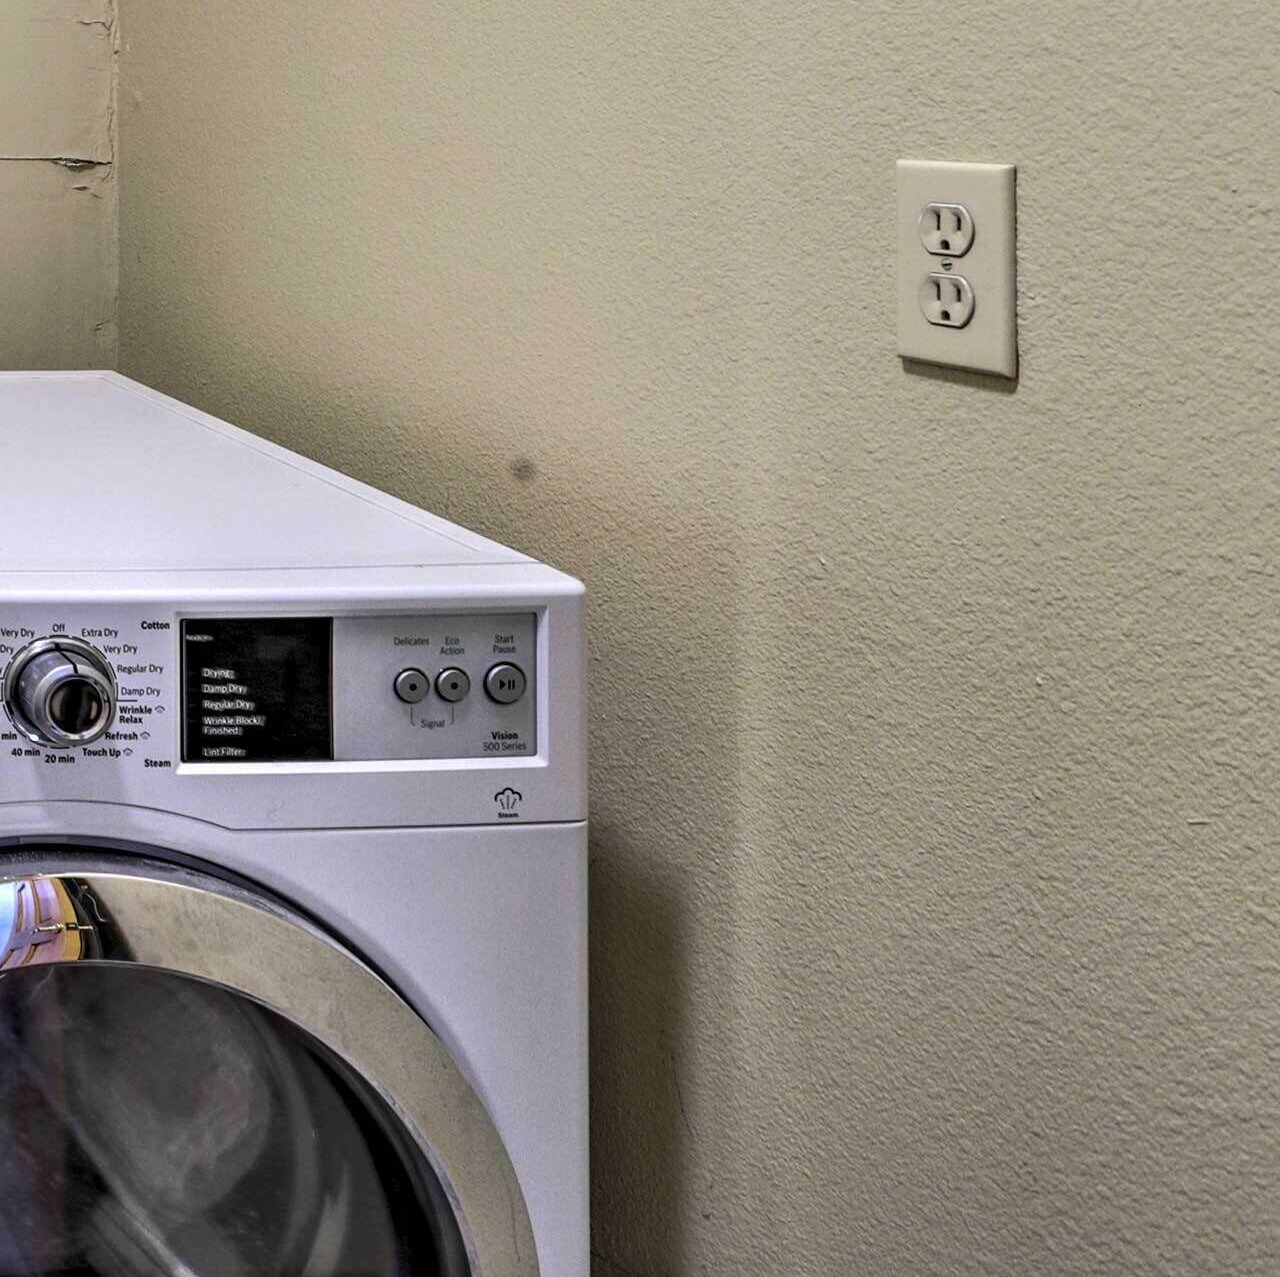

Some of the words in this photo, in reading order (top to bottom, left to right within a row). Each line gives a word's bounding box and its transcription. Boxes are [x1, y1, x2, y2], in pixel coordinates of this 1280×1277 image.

[52, 624, 66, 633] Off
[141, 621, 171, 630] Cotton
[0, 628, 20, 639] Very
[20, 628, 36, 639] Dry
[81, 628, 101, 637] Extra
[103, 628, 119, 639] Dry
[394, 637, 430, 646] Delicates
[445, 637, 460, 645] Eco
[495, 635, 514, 644] Start
[0, 644, 15, 656] Dry
[103, 644, 121, 655] Very
[122, 644, 138, 655] Dry
[440, 647, 465, 655] Action
[493, 645, 517, 654] Pause
[117, 664, 146, 675] Regular
[147, 664, 164, 675] Dry
[202, 668, 235, 679] Drying
[121, 687, 145, 698] Damp
[145, 687, 161, 698] Dry
[202, 684, 227, 695] Damp
[228, 684, 247, 695] Dry
[119, 705, 152, 714] Wrinkle
[203, 700, 235, 711] Regular
[236, 700, 254, 711] Dry
[119, 716, 143, 724] Relax
[203, 717, 235, 726] Wrinkle
[421, 719, 445, 729] Signal
[204, 727, 242, 735] Finished
[491, 731, 518, 740] Vision
[1, 732, 18, 741] min
[105, 731, 138, 741] Refresh
[483, 742, 500, 751] 500
[502, 741, 527, 751] Series
[11, 748, 23, 757] 40
[24, 748, 41, 757] min
[82, 748, 108, 757] Touch
[109, 748, 121, 759] Up
[203, 748, 220, 757] Lint
[221, 748, 245, 757] Filter
[45, 754, 57, 764] 20
[58, 754, 75, 764] min
[144, 759, 171, 768] Steam
